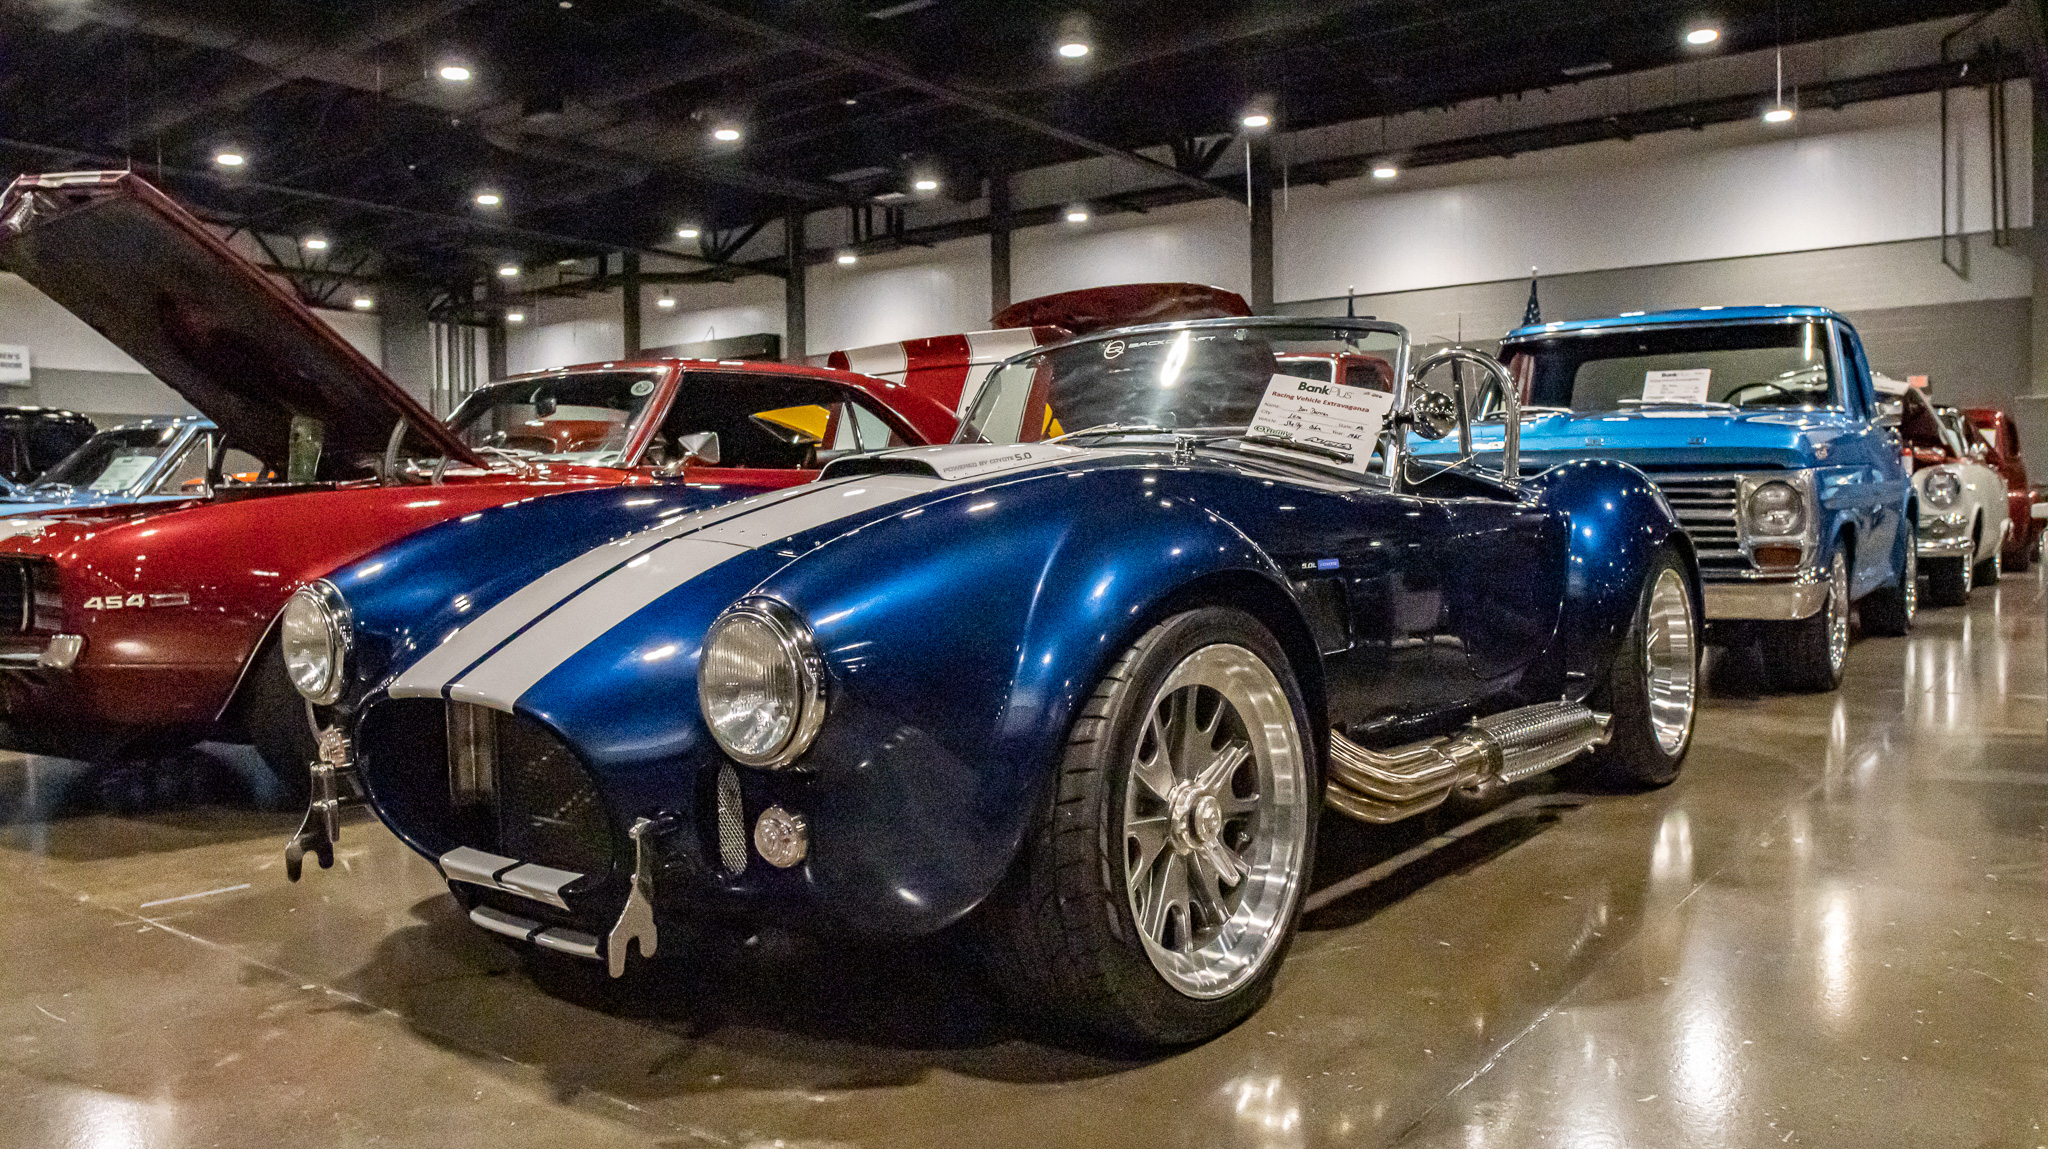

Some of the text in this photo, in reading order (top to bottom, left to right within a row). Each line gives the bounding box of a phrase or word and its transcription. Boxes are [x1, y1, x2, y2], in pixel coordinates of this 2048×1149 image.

[1128, 336, 1216, 348] BACKDAFT
[1272, 391, 1370, 413] Racing Vehicle Extravaganza
[943, 463, 977, 473] POWERED
[989, 455, 1014, 465] COYOTE
[1015, 452, 1032, 461] 5.0
[83, 593, 145, 610] 454
